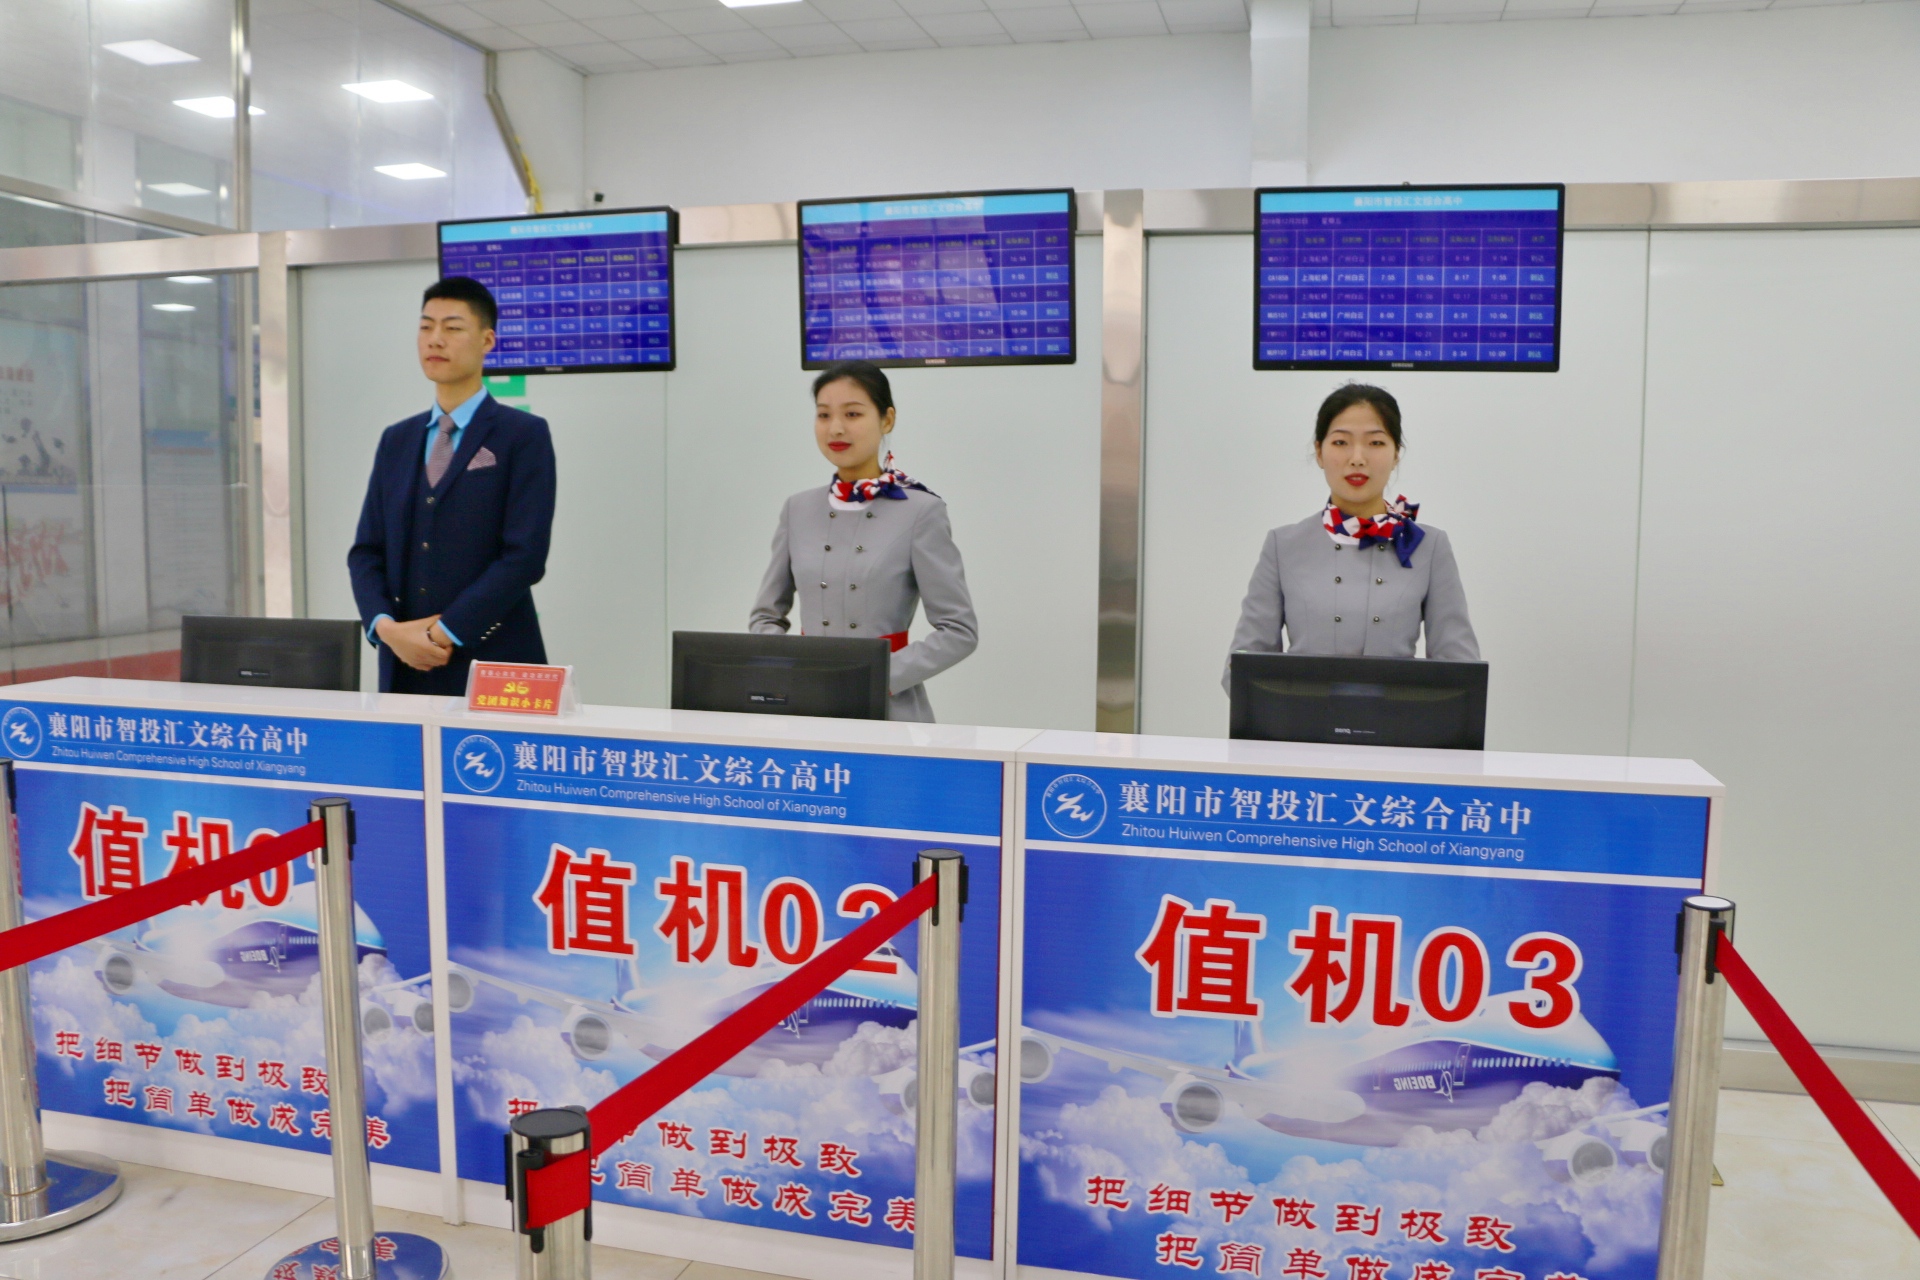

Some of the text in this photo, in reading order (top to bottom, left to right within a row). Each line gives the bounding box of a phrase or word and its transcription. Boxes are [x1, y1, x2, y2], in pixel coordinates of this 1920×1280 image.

[1301, 273, 1328, 282] 上海虹桥
[1337, 273, 1364, 282] 广州白云
[1415, 273, 1433, 281] 10:06
[1301, 310, 1328, 319] 上海虹桥
[1337, 310, 1364, 319] 广州白云
[1337, 348, 1364, 357] 广州白云
[477, 694, 553, 710] 党团知识小卡片
[47, 712, 308, 755] 襄阳市智投汇文综合高中
[52, 745, 306, 776] Zhitou Huiwen Comprehensive High School of Xiangyang
[513, 741, 851, 795] 襄阳市智投汇文综合高中
[517, 779, 847, 818] Zhitou Huiwen Comprehensive High School of Xiangyang
[1118, 780, 1532, 836] 襄阳市智投汇文综合高中
[70, 803, 316, 910] 值机0
[1122, 823, 1525, 862] Zhitou Huiwen Comprehensive High School of Xiangyang
[535, 846, 899, 976] 值机02
[1140, 896, 1582, 1029] 值机03
[1087, 1175, 1515, 1252] 把细节做到极致
